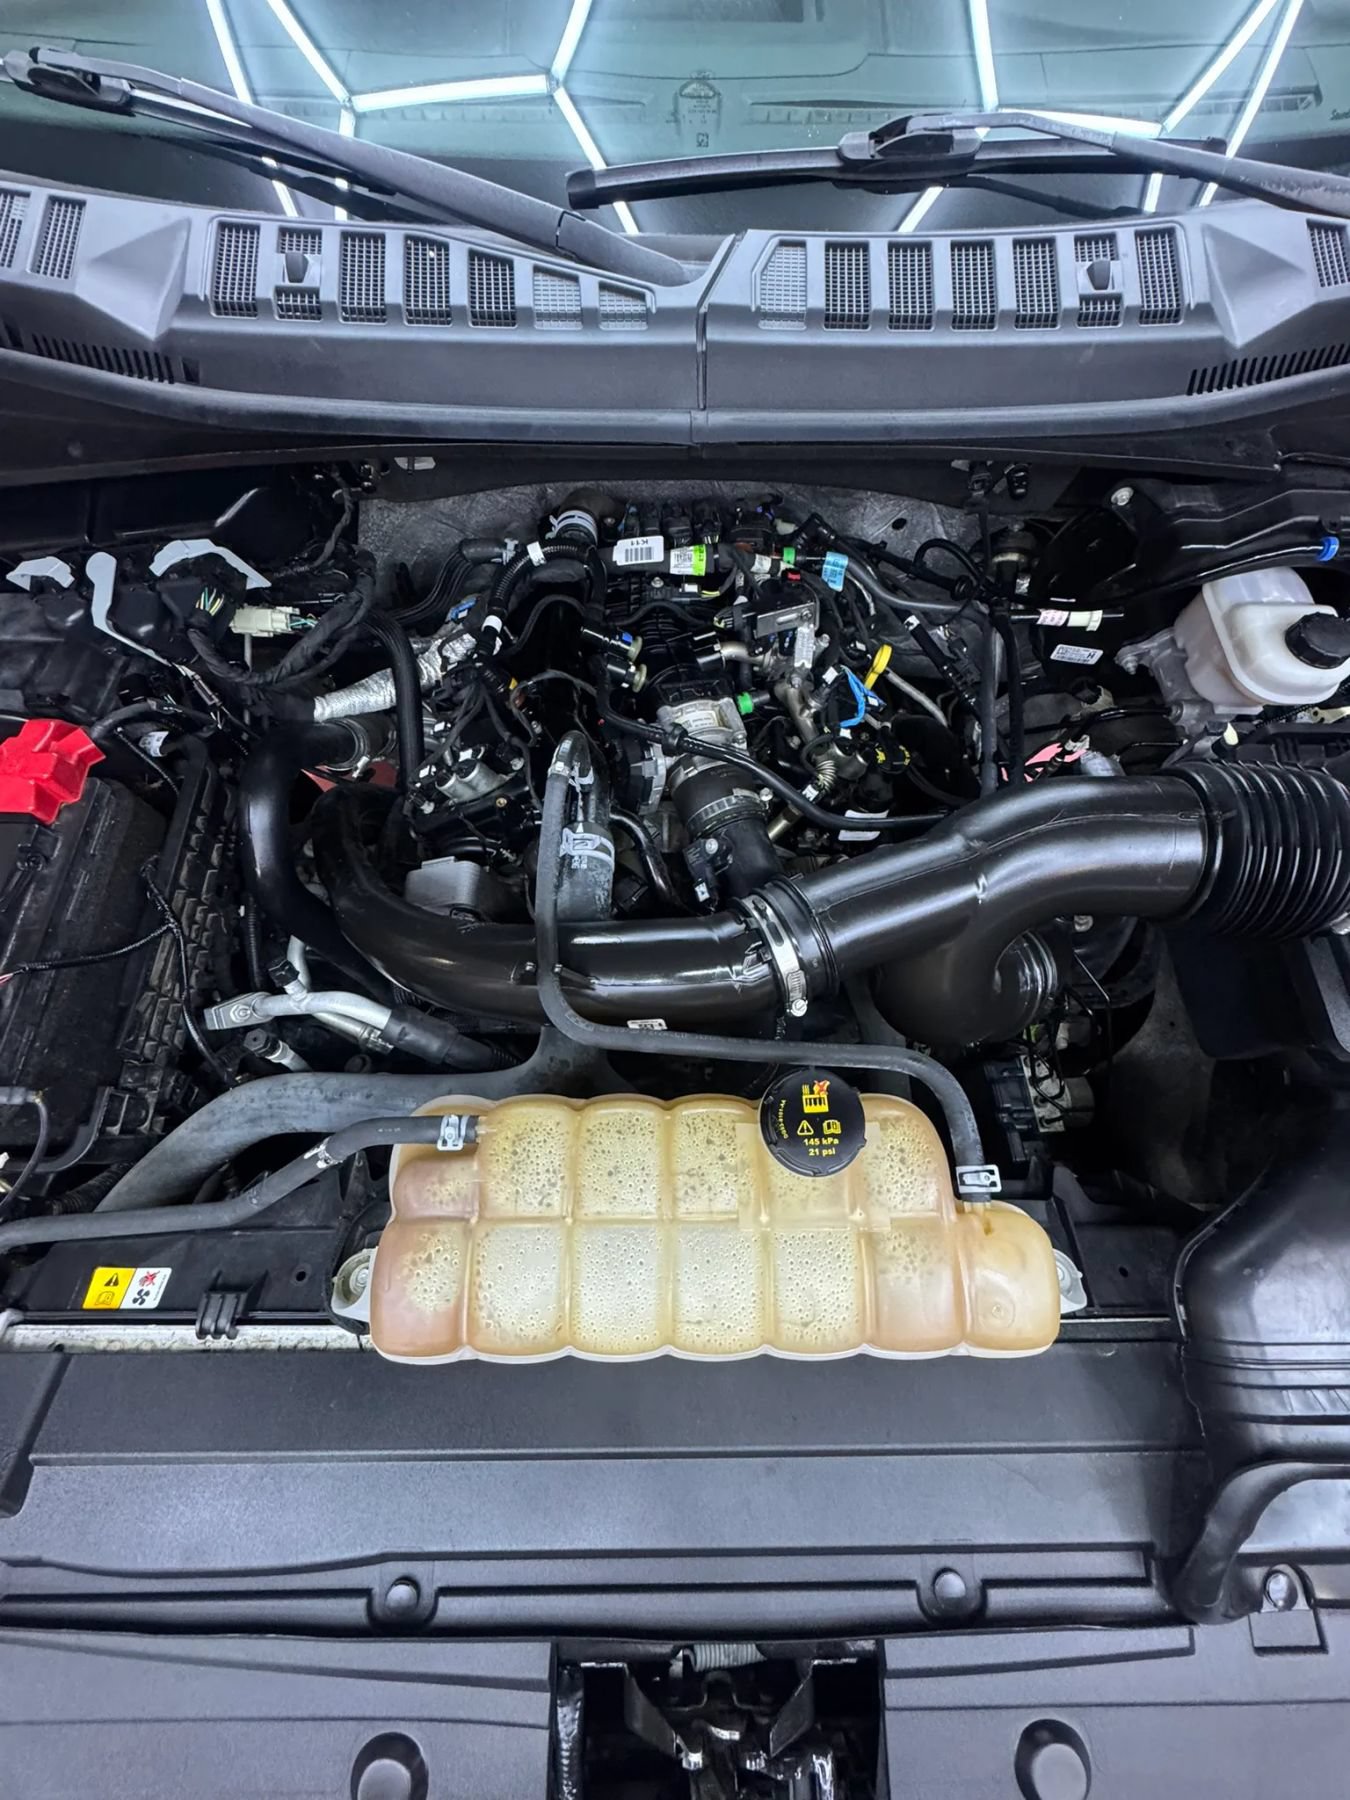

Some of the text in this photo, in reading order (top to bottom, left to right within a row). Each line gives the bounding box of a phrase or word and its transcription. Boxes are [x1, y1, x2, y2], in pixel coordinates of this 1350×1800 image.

[803, 1137, 839, 1146] 145 kPa
[808, 1147, 835, 1157] 21 psi
